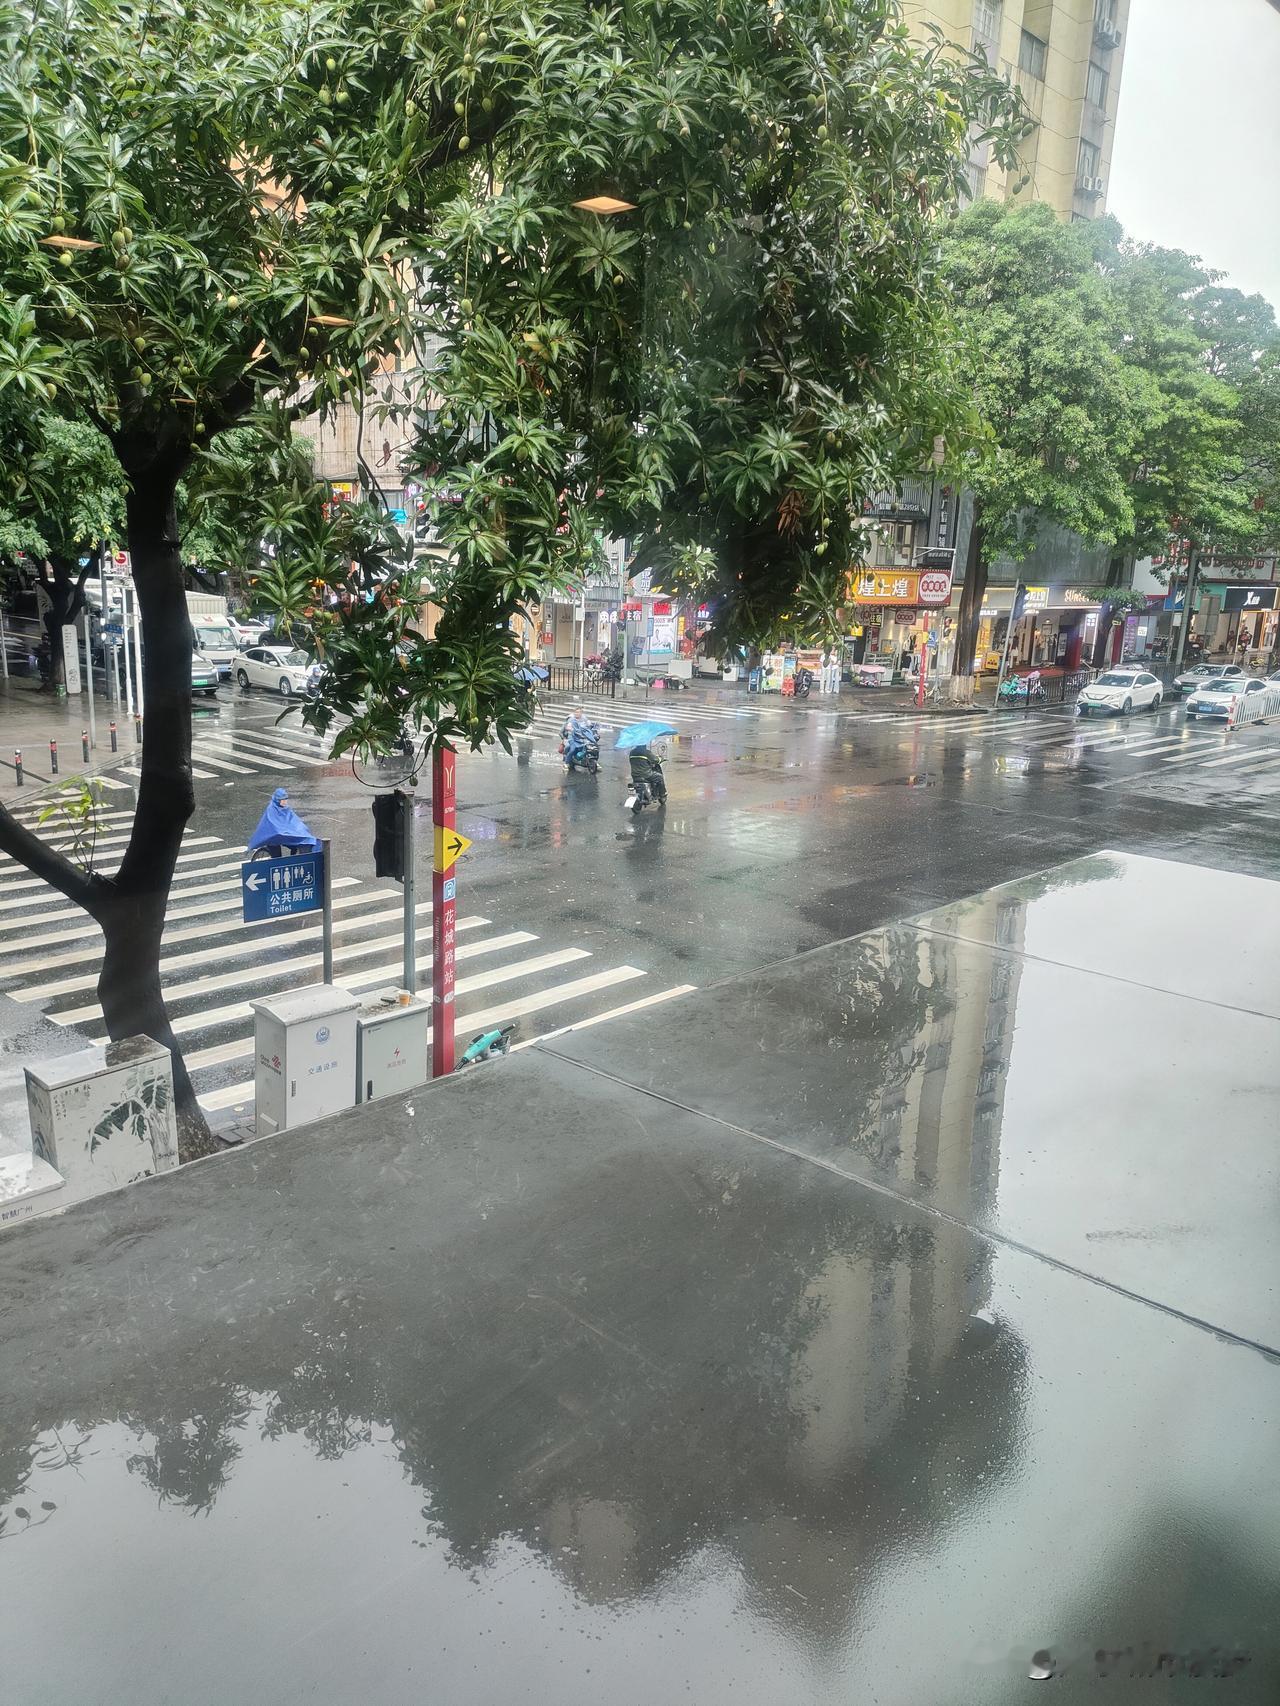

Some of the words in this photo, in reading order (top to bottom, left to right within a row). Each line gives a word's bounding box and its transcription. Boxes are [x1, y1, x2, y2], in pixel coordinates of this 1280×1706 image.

[857, 577, 908, 598] 煌上煌
[270, 887, 314, 906] 公共厕所
[270, 904, 292, 914] Toilet
[444, 908, 454, 985] 花城路站
